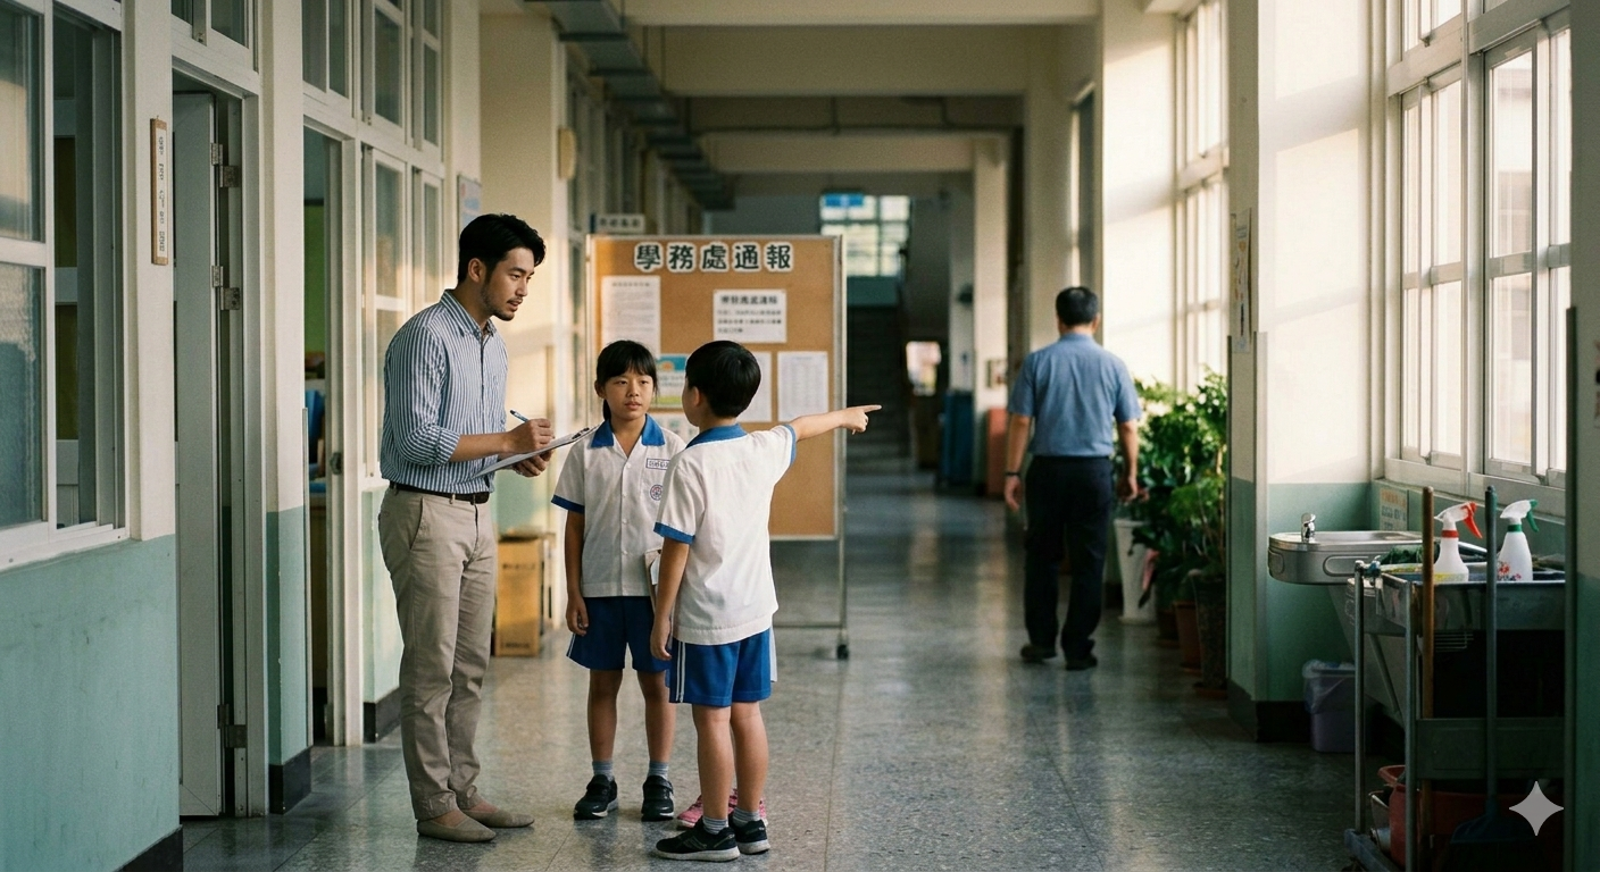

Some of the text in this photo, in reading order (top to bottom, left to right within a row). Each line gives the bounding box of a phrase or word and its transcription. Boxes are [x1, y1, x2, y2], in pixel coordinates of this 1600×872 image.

[636, 244, 792, 271] 學務處通報
